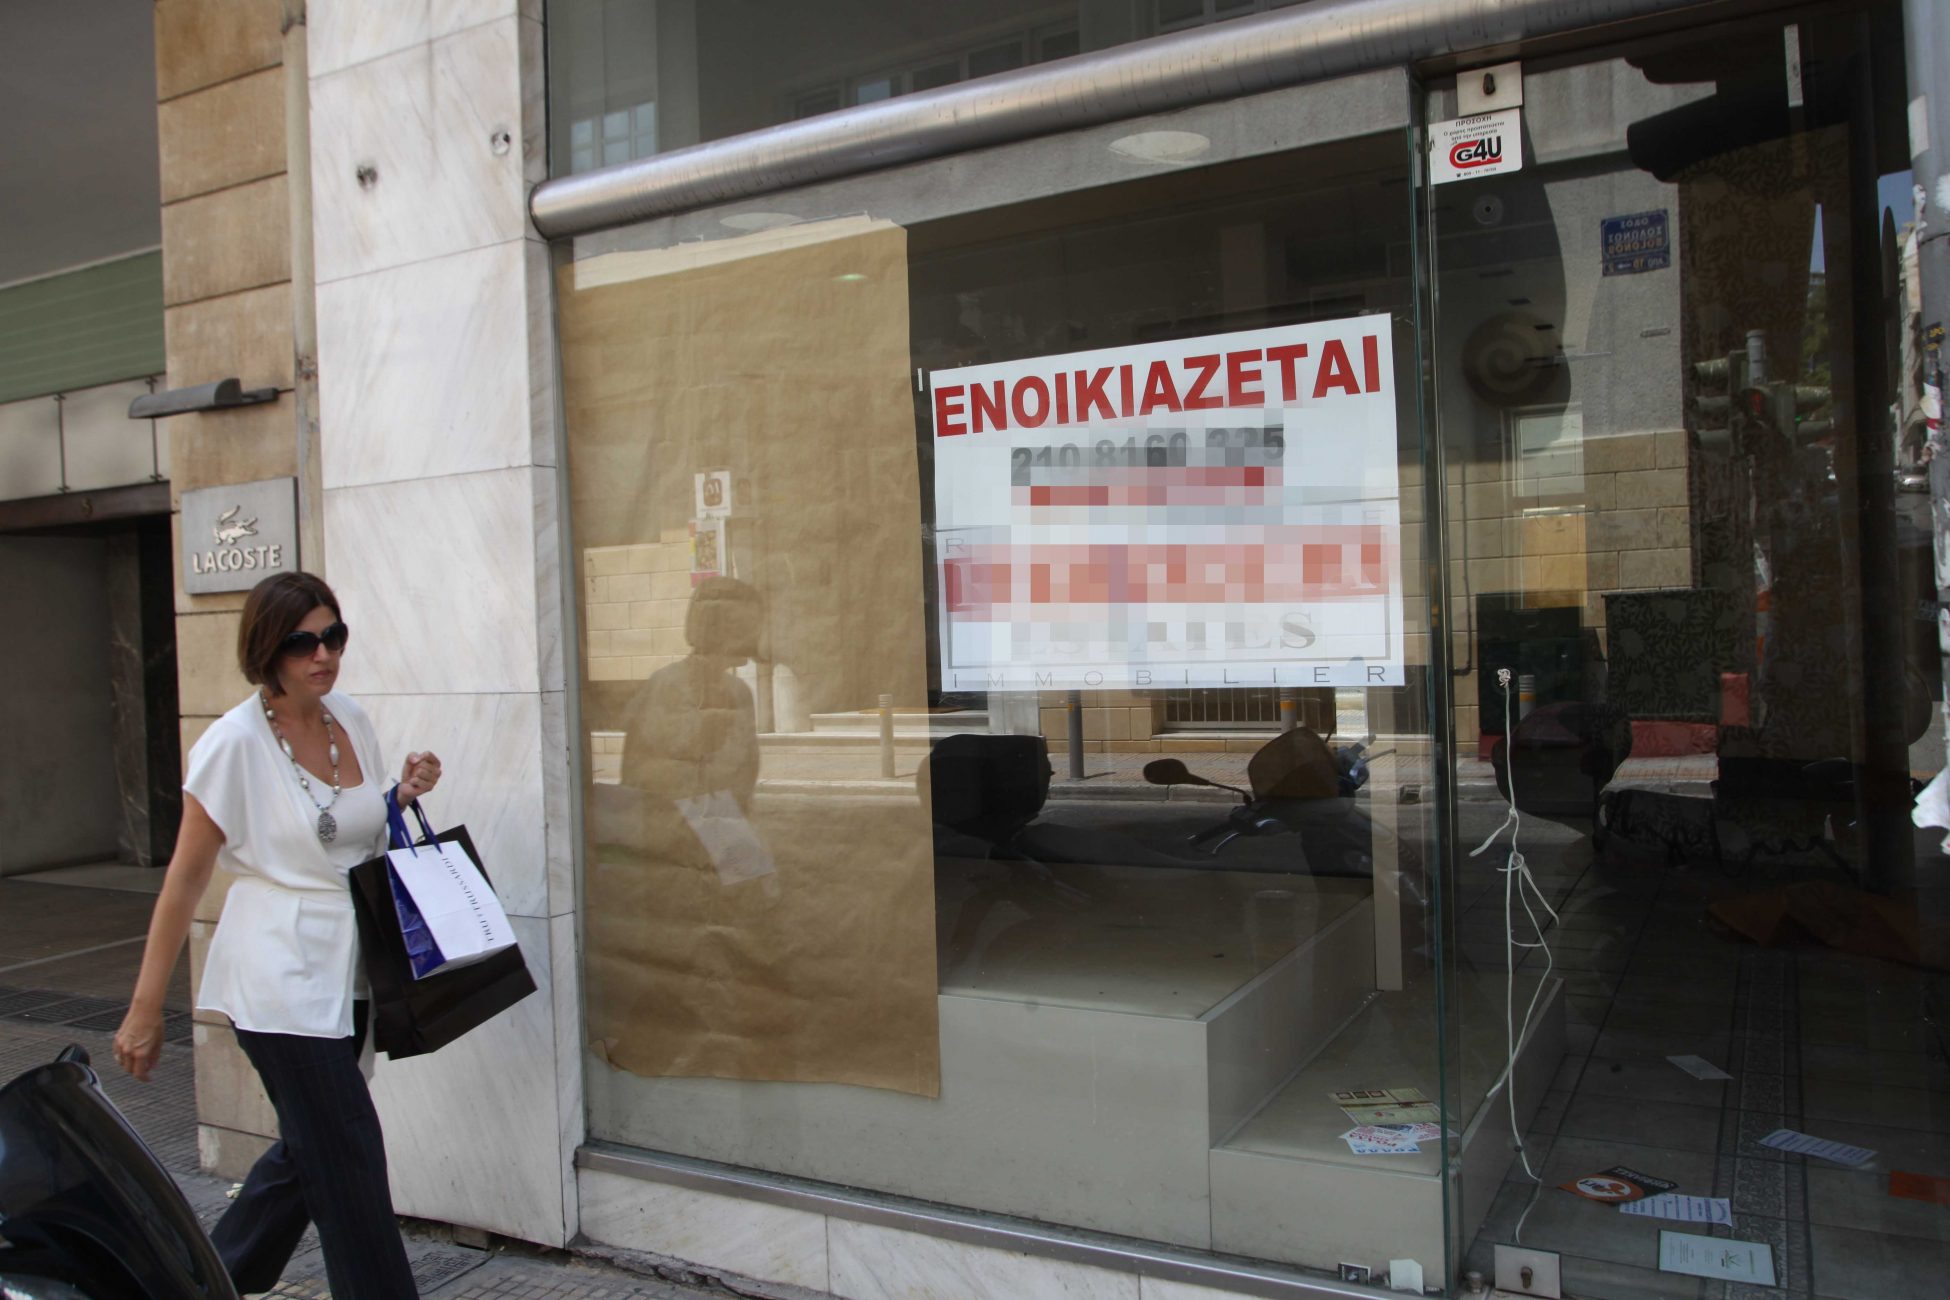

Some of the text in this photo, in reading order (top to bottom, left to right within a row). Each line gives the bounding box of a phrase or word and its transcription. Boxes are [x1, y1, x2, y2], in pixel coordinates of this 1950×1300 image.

[1455, 115, 1492, 127] ΠΡΟΣΟΧΗ
[1456, 136, 1502, 161] G4U
[934, 335, 1381, 437] ΕΝΟΙΚΙΑΖΕΤΑΙ
[192, 544, 282, 574] LACOSTE
[953, 665, 1386, 689] IMMOBILIER
